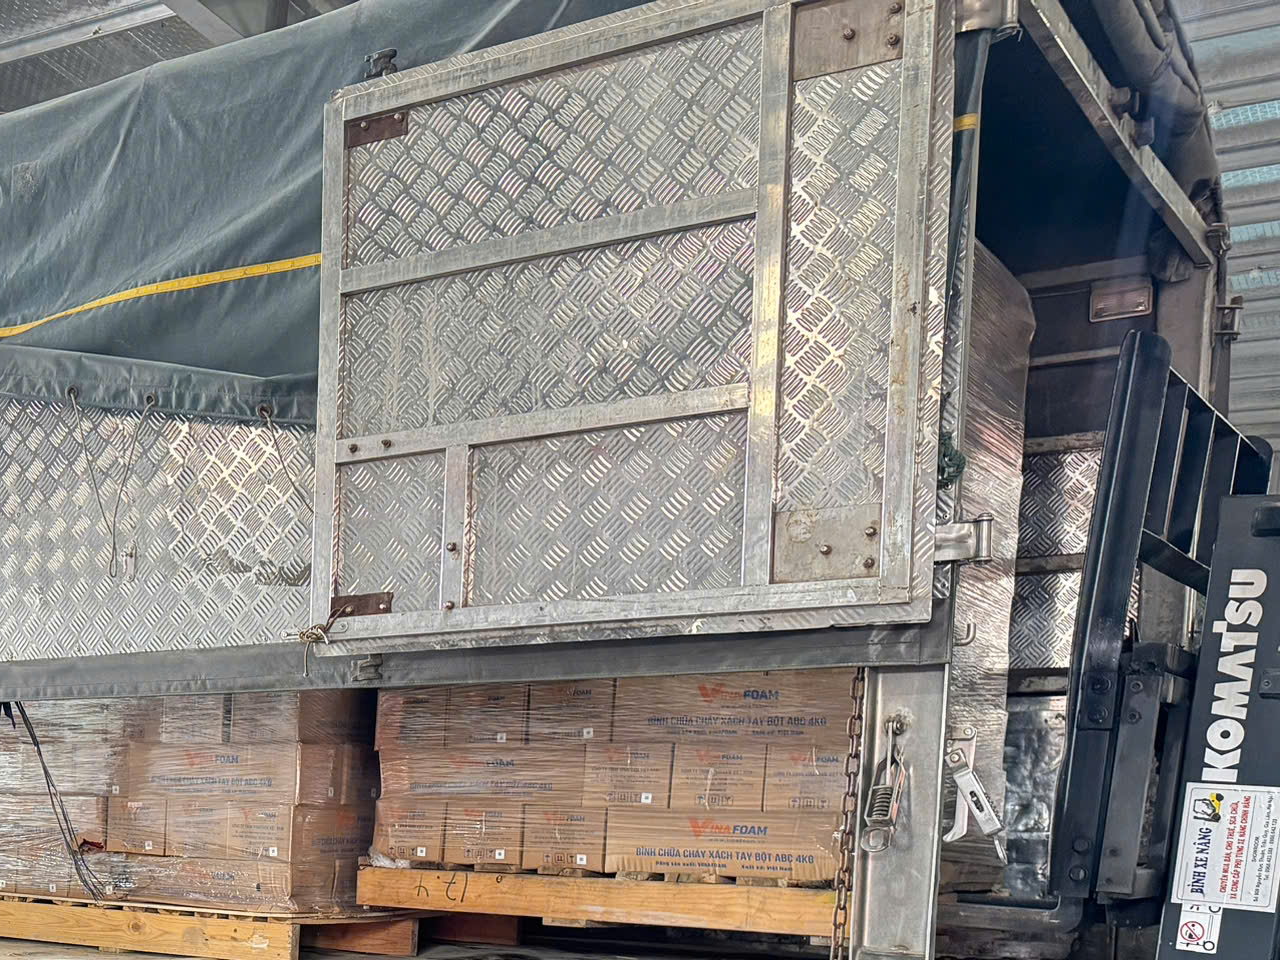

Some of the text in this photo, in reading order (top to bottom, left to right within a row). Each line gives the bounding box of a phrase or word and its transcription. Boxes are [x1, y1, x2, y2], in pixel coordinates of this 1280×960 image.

[1201, 568, 1268, 783] KOMATSU
[689, 817, 768, 838] VINAFOAM
[636, 846, 656, 857] BÌNH
[658, 846, 681, 858] CHỮA
[736, 852, 752, 861] TAY
[754, 850, 773, 863] BỘT
[775, 853, 793, 863] ABC
[795, 854, 814, 864] 4KG
[1187, 827, 1212, 894] BÌNH XE NÂNG
